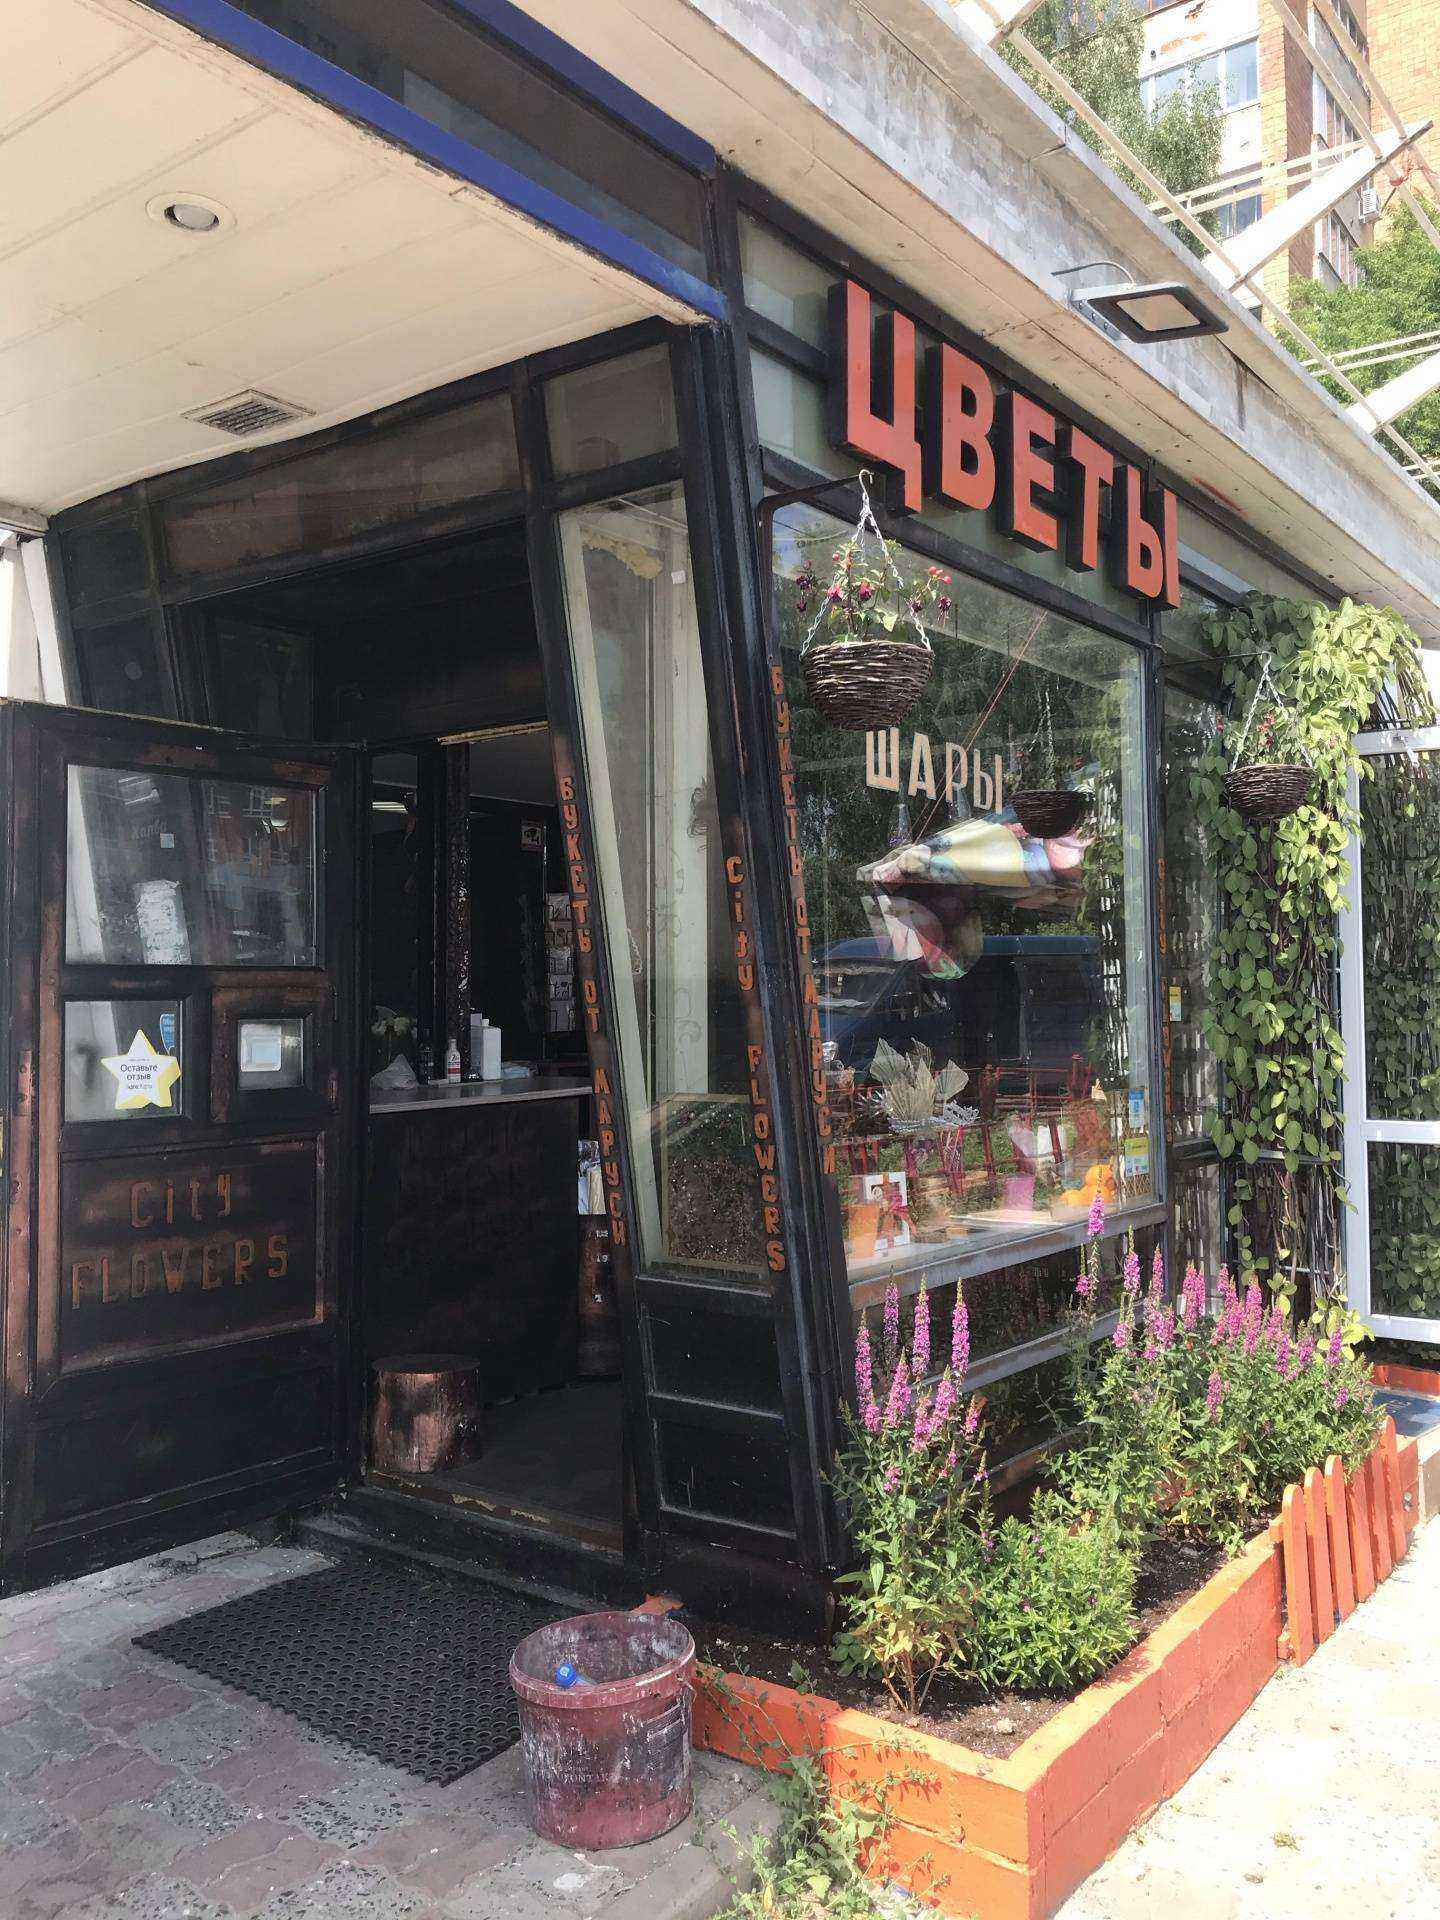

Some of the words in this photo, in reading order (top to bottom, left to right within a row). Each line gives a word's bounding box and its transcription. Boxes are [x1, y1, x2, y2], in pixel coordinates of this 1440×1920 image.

[844, 278, 1181, 610] ЦВЕТЫ
[865, 726, 1003, 816] ШАРЫ
[583, 978, 600, 1033] ОТ
[120, 1063, 159, 1073] Оставьте
[126, 1073, 152, 1081] отзыв
[746, 1044, 787, 1272] FLOWERS
[71, 1234, 289, 1310] FLOWERS
